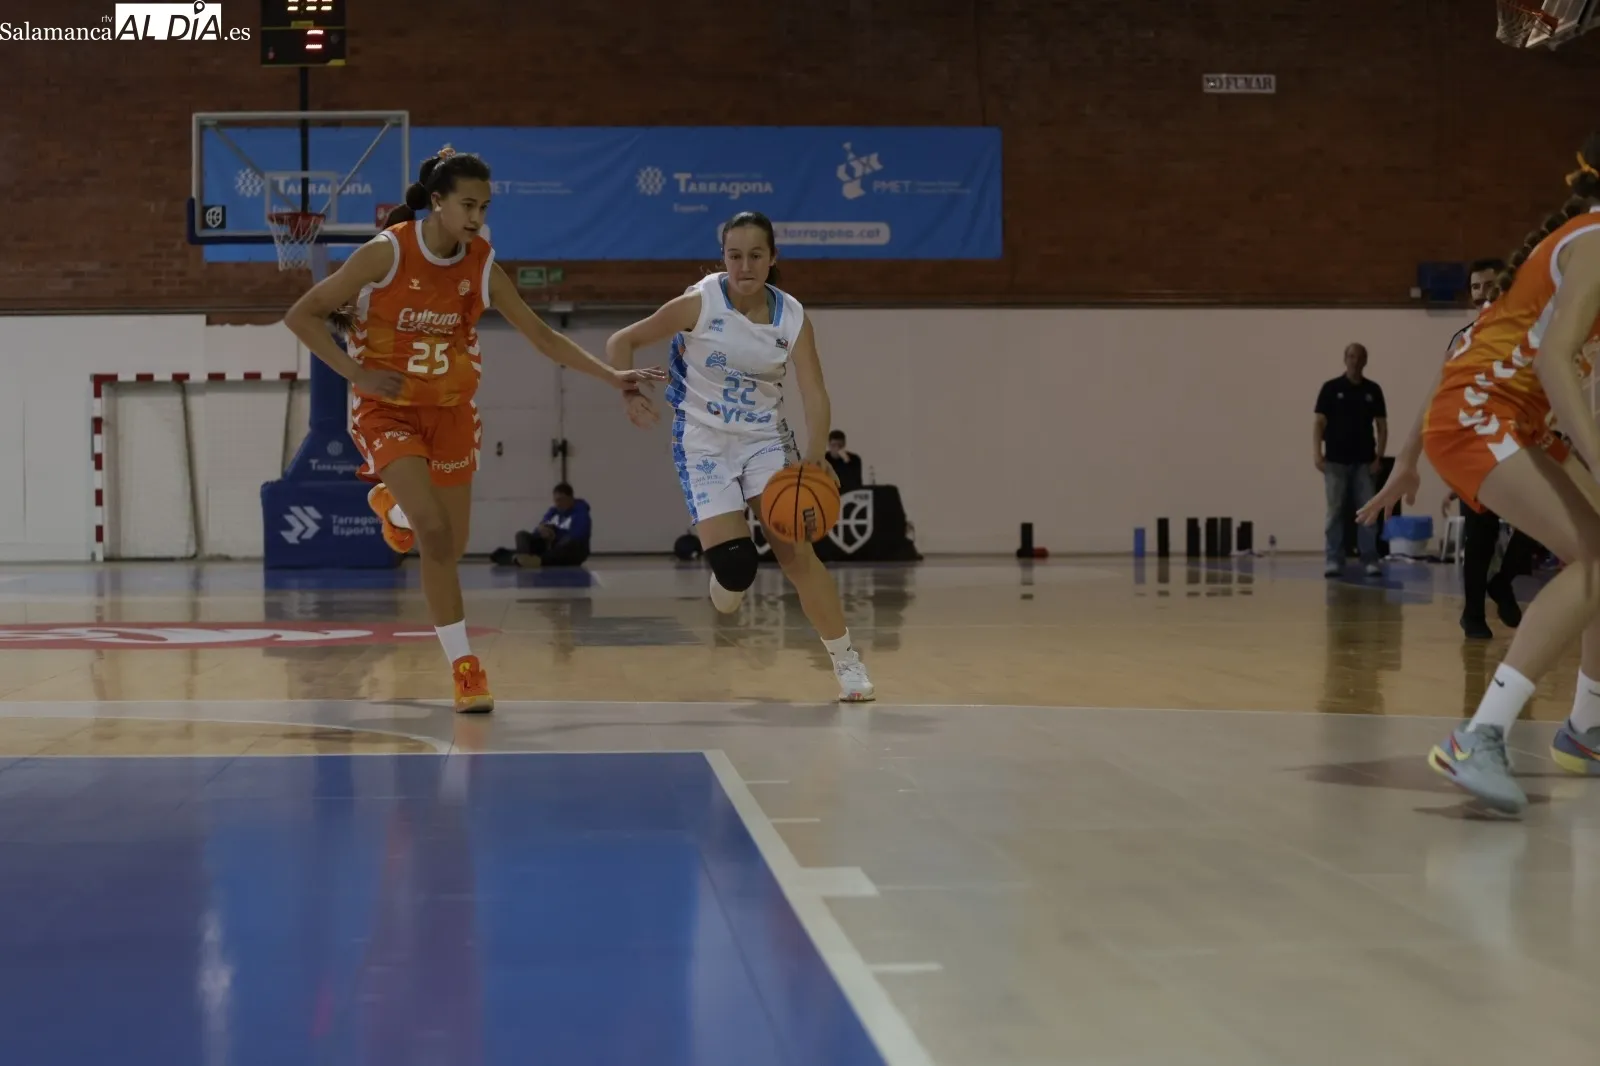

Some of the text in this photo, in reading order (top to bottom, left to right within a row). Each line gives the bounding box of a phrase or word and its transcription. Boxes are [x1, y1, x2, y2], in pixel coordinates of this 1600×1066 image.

[1225, 76, 1273, 89] FUMAR
[407, 342, 450, 375] 25
[722, 376, 757, 406] 22
